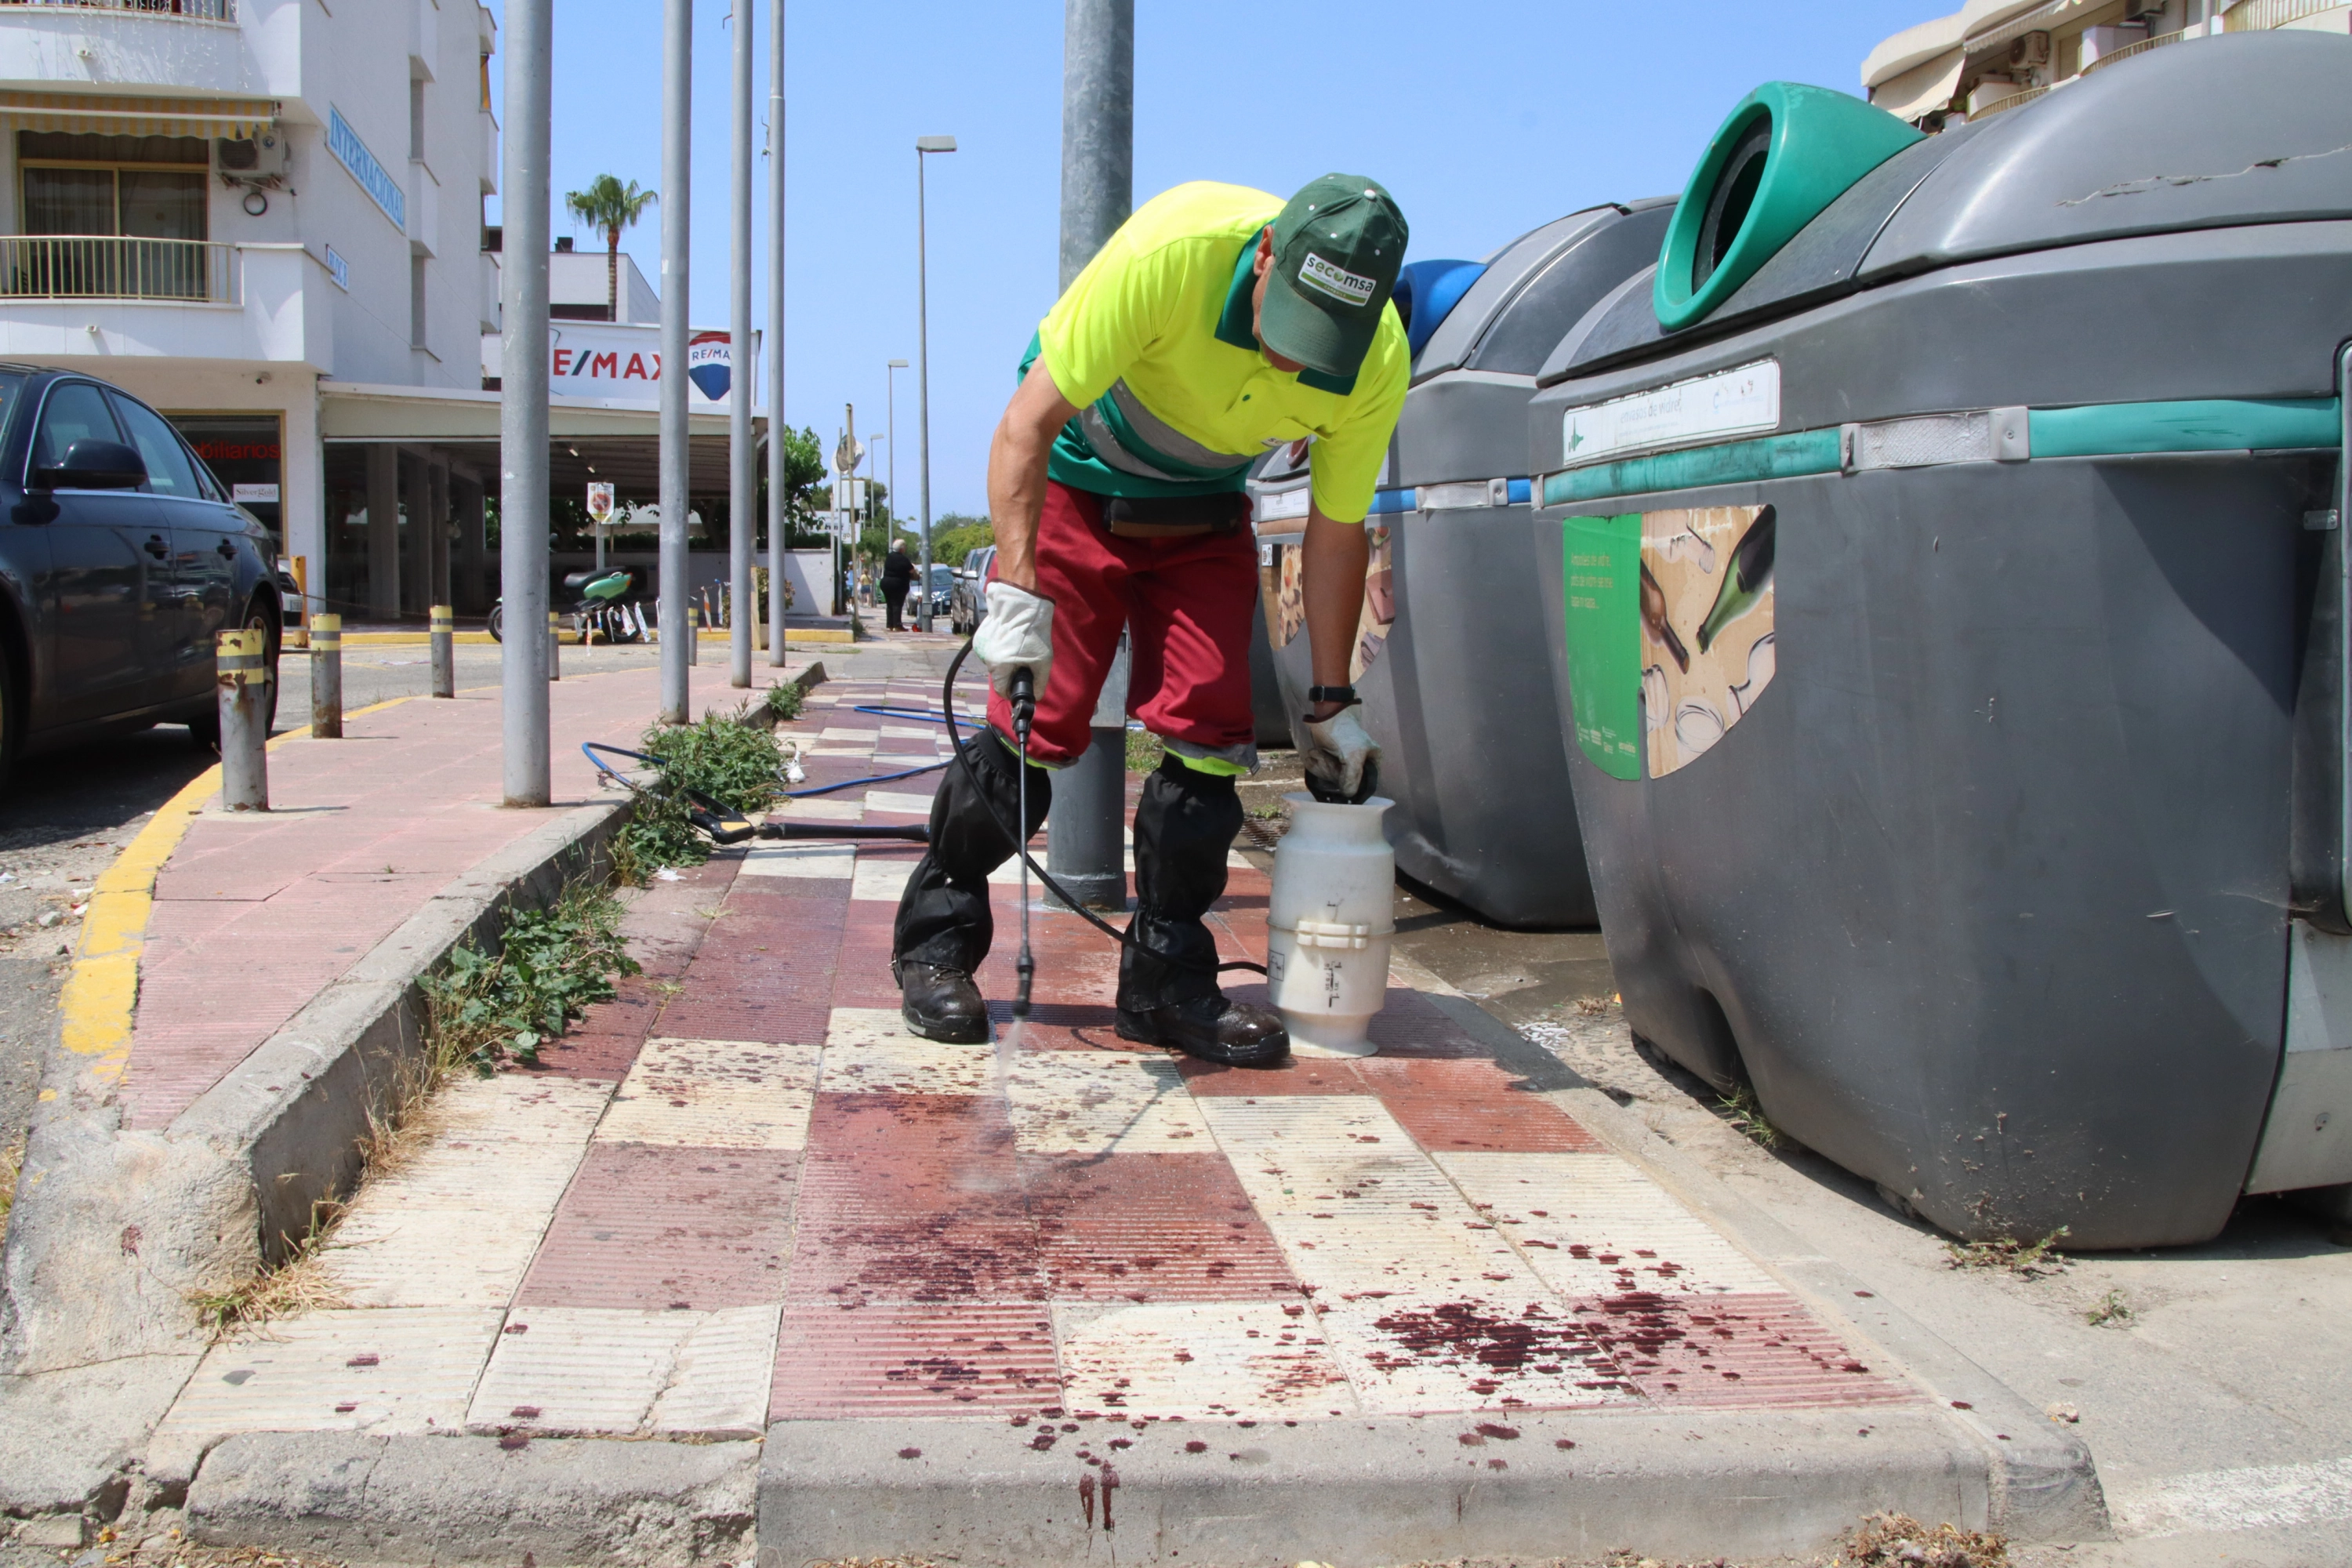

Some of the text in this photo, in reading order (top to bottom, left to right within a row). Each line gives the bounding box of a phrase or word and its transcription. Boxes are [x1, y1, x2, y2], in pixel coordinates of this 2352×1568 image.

[330, 108, 405, 228] INTERNACIONAL
[1307, 257, 1374, 292] secomsa
[554, 349, 660, 380] E/MA
[691, 349, 730, 361] RE/MA
[1648, 401, 1657, 416] de
[192, 441, 280, 459] obiliarios
